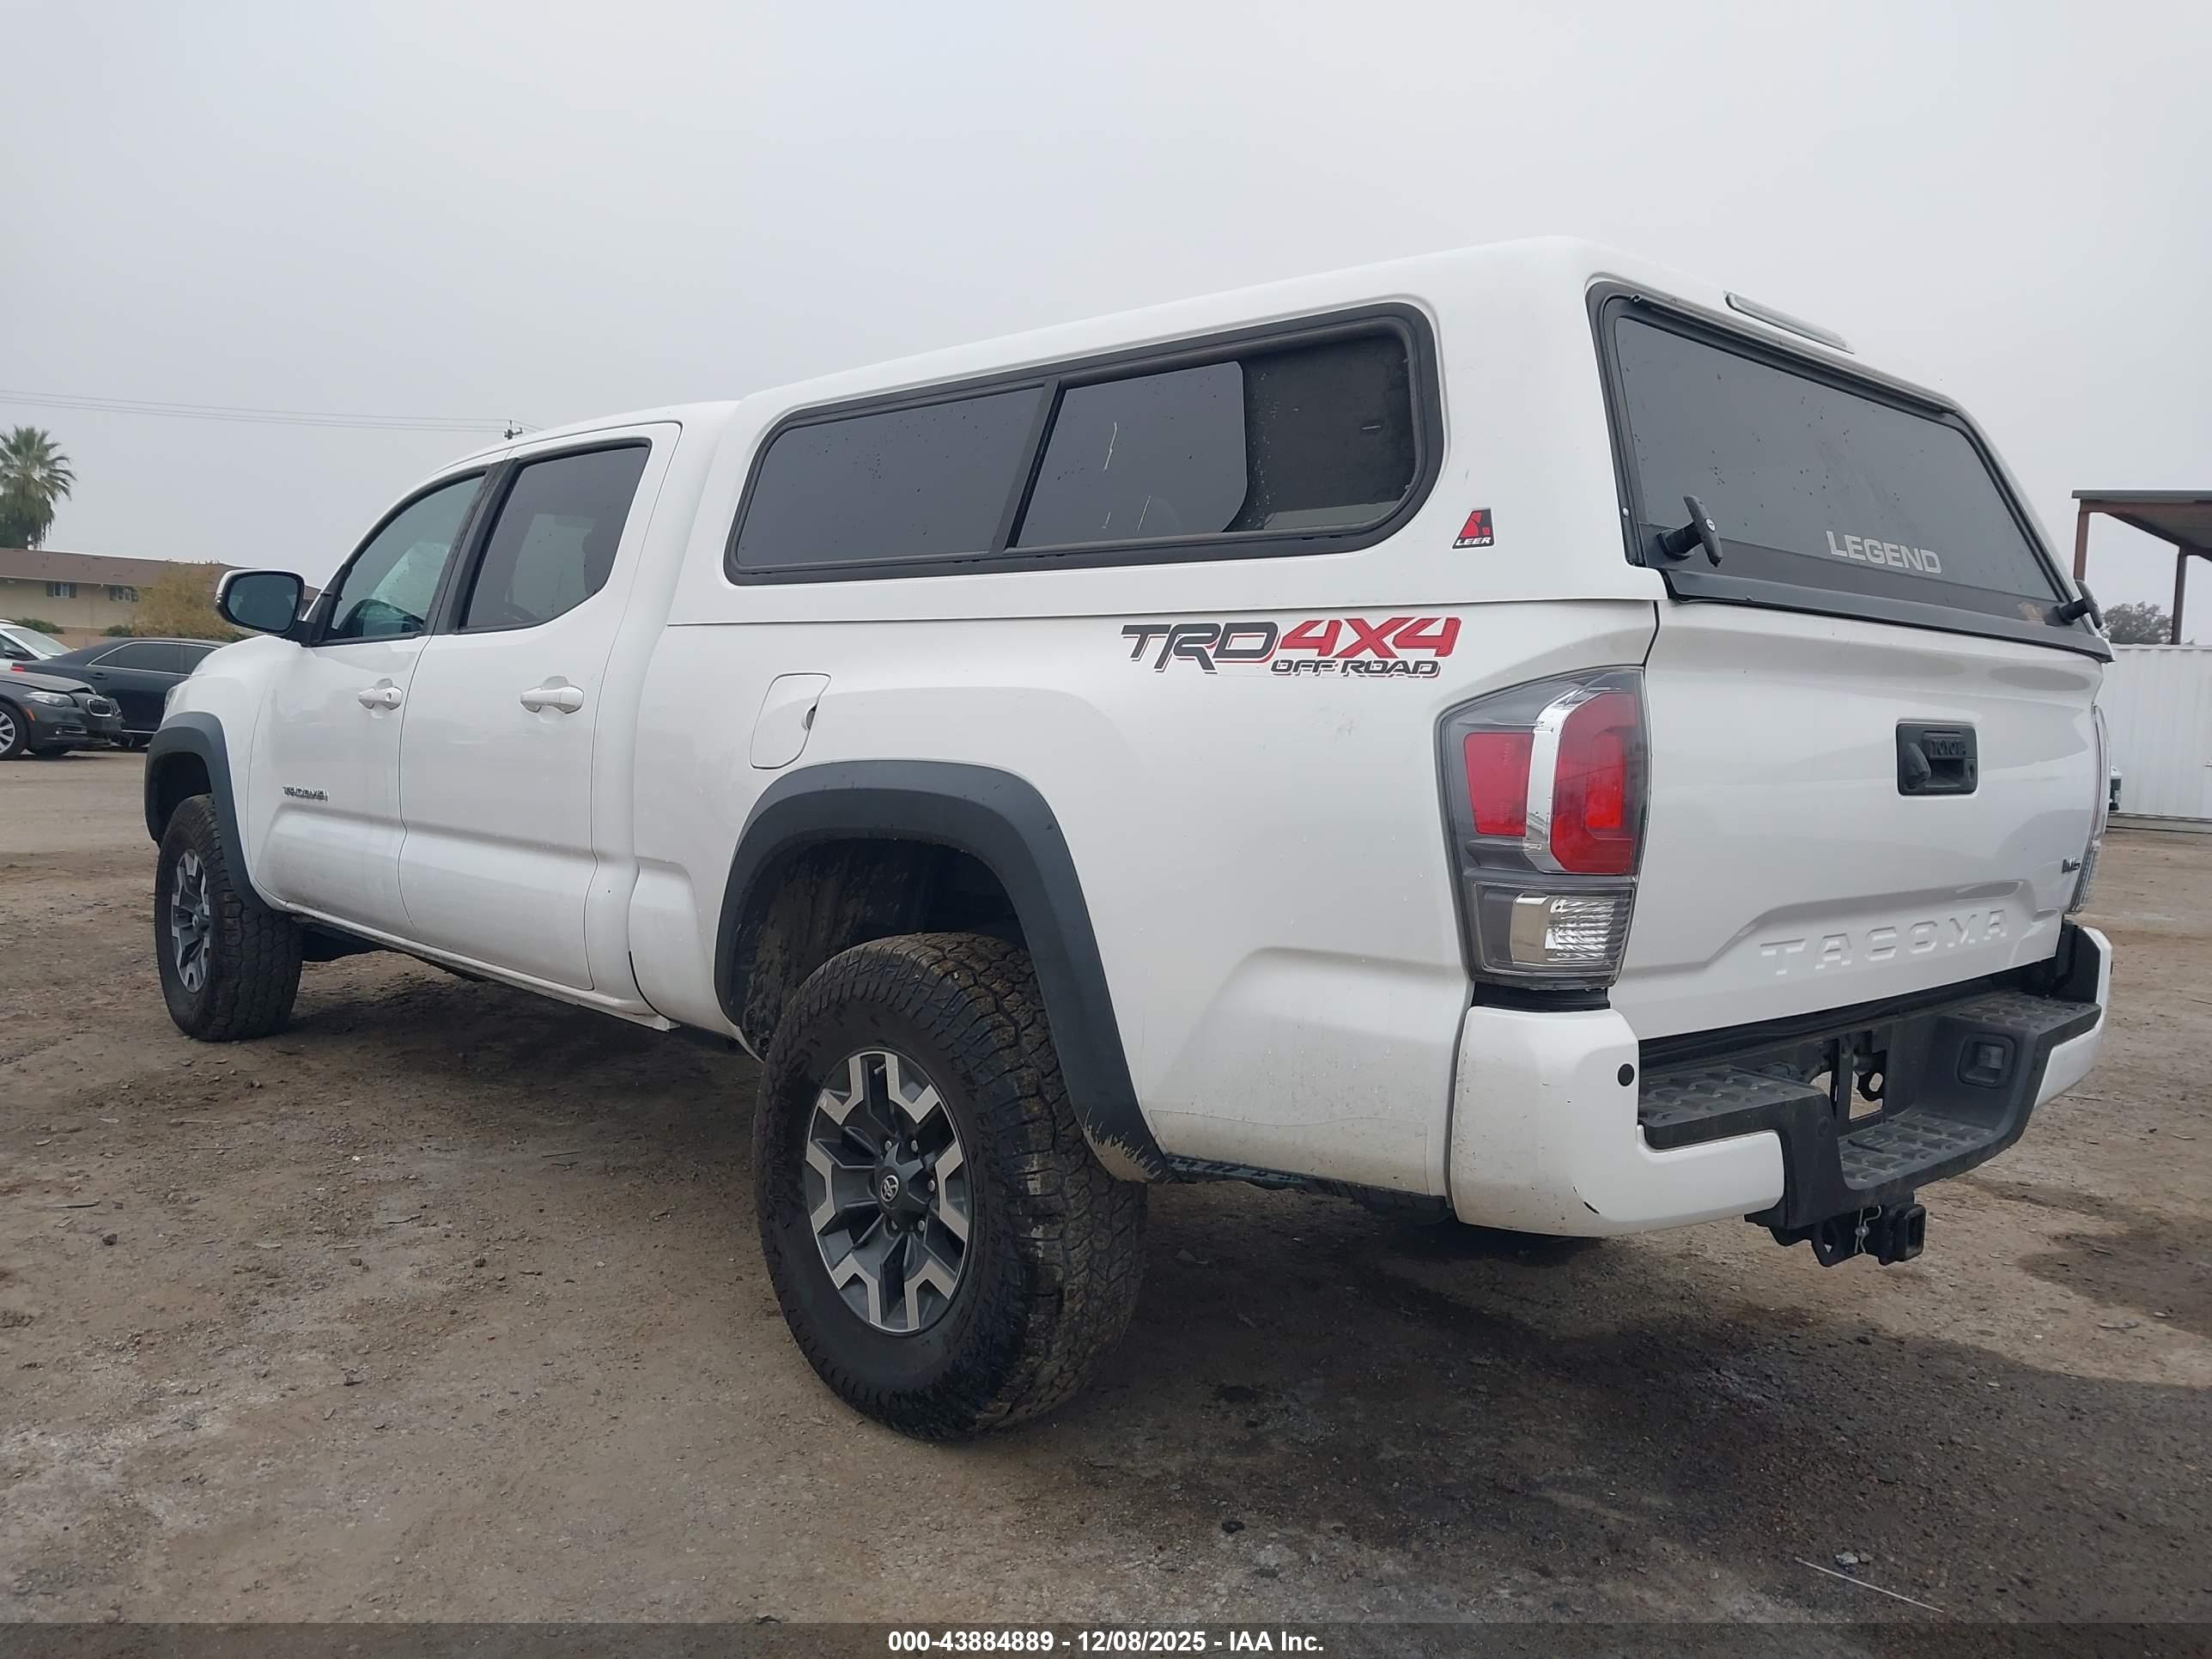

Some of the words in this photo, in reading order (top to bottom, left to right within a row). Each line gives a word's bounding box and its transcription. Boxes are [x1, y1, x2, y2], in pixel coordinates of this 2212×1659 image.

[1455, 537, 1492, 546] LEER
[1826, 529, 1943, 574] LEGEND
[1120, 621, 1280, 675] TRD
[1279, 616, 1462, 659] 4X4
[1270, 659, 1338, 678] OFF
[1340, 659, 1443, 678] ROAD
[1759, 908, 2008, 976] TACOMA
